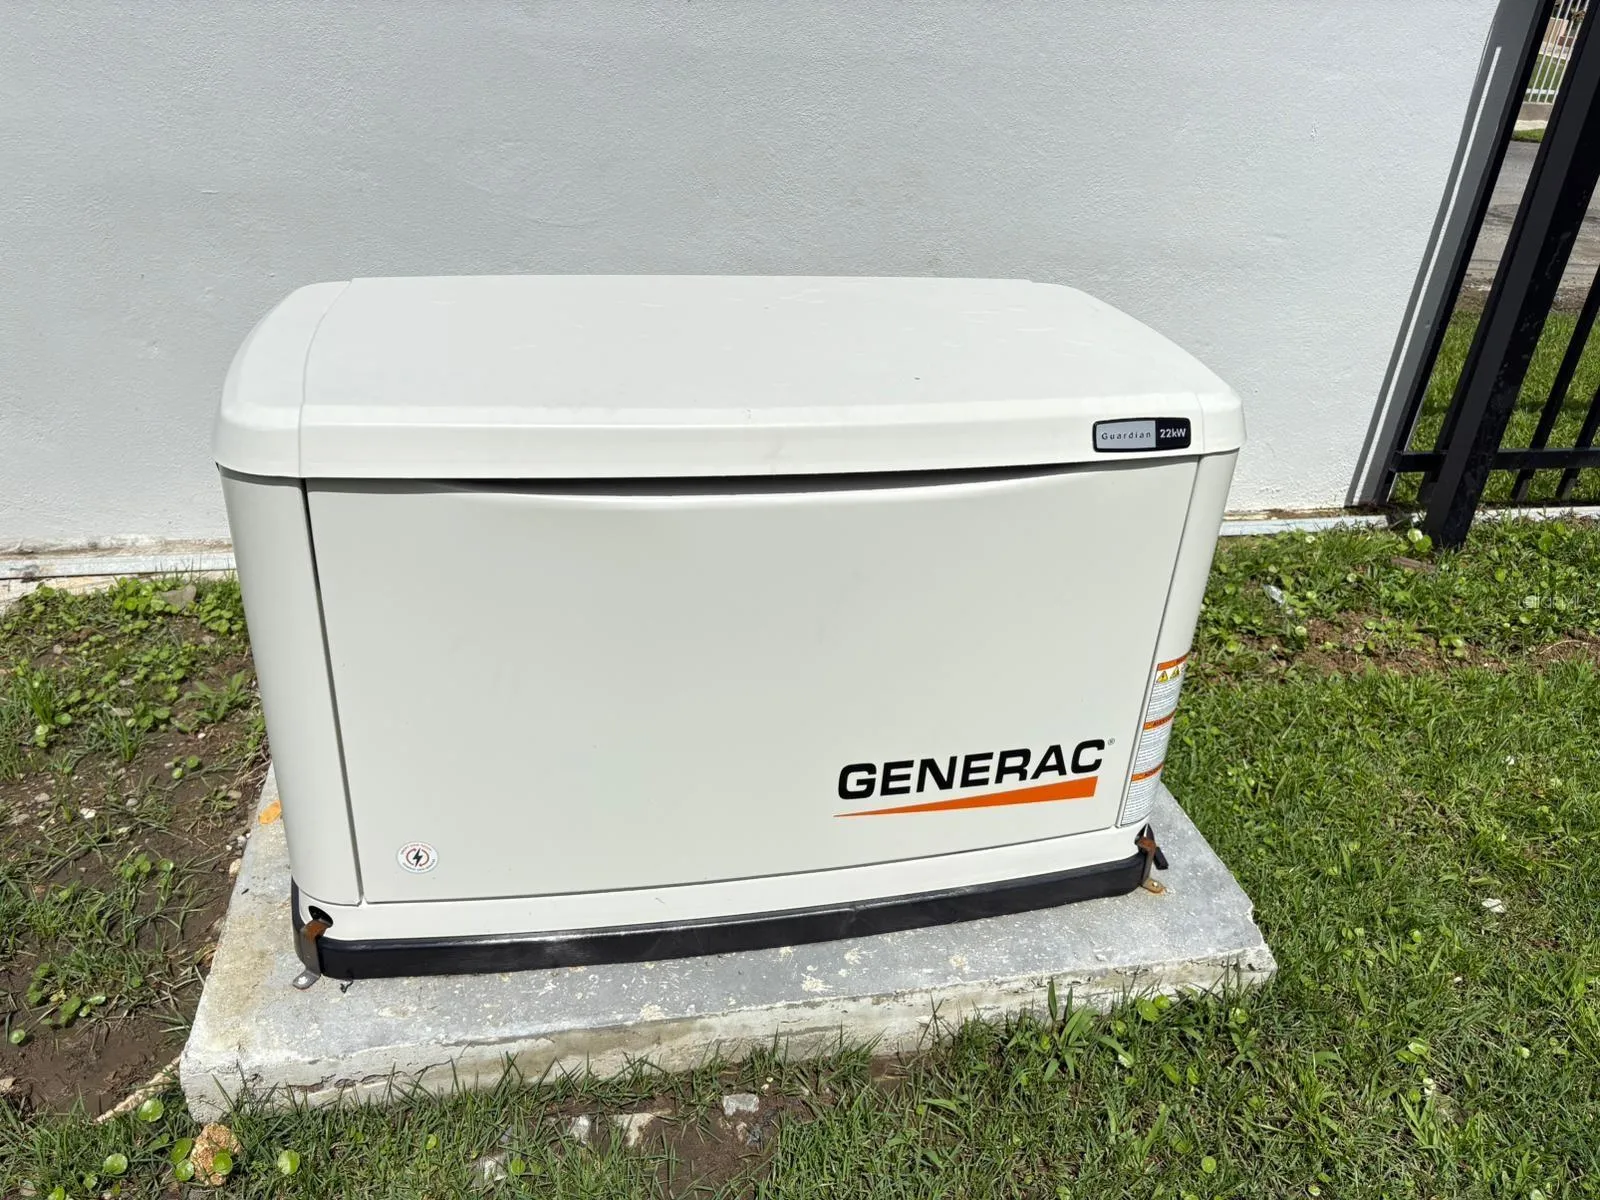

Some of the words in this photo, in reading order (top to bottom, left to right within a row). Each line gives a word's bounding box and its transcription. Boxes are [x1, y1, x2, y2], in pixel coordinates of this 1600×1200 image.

[1101, 431, 1151, 440] Guardian
[1160, 428, 1187, 438] 22kW
[838, 739, 1105, 800] GENERAC
